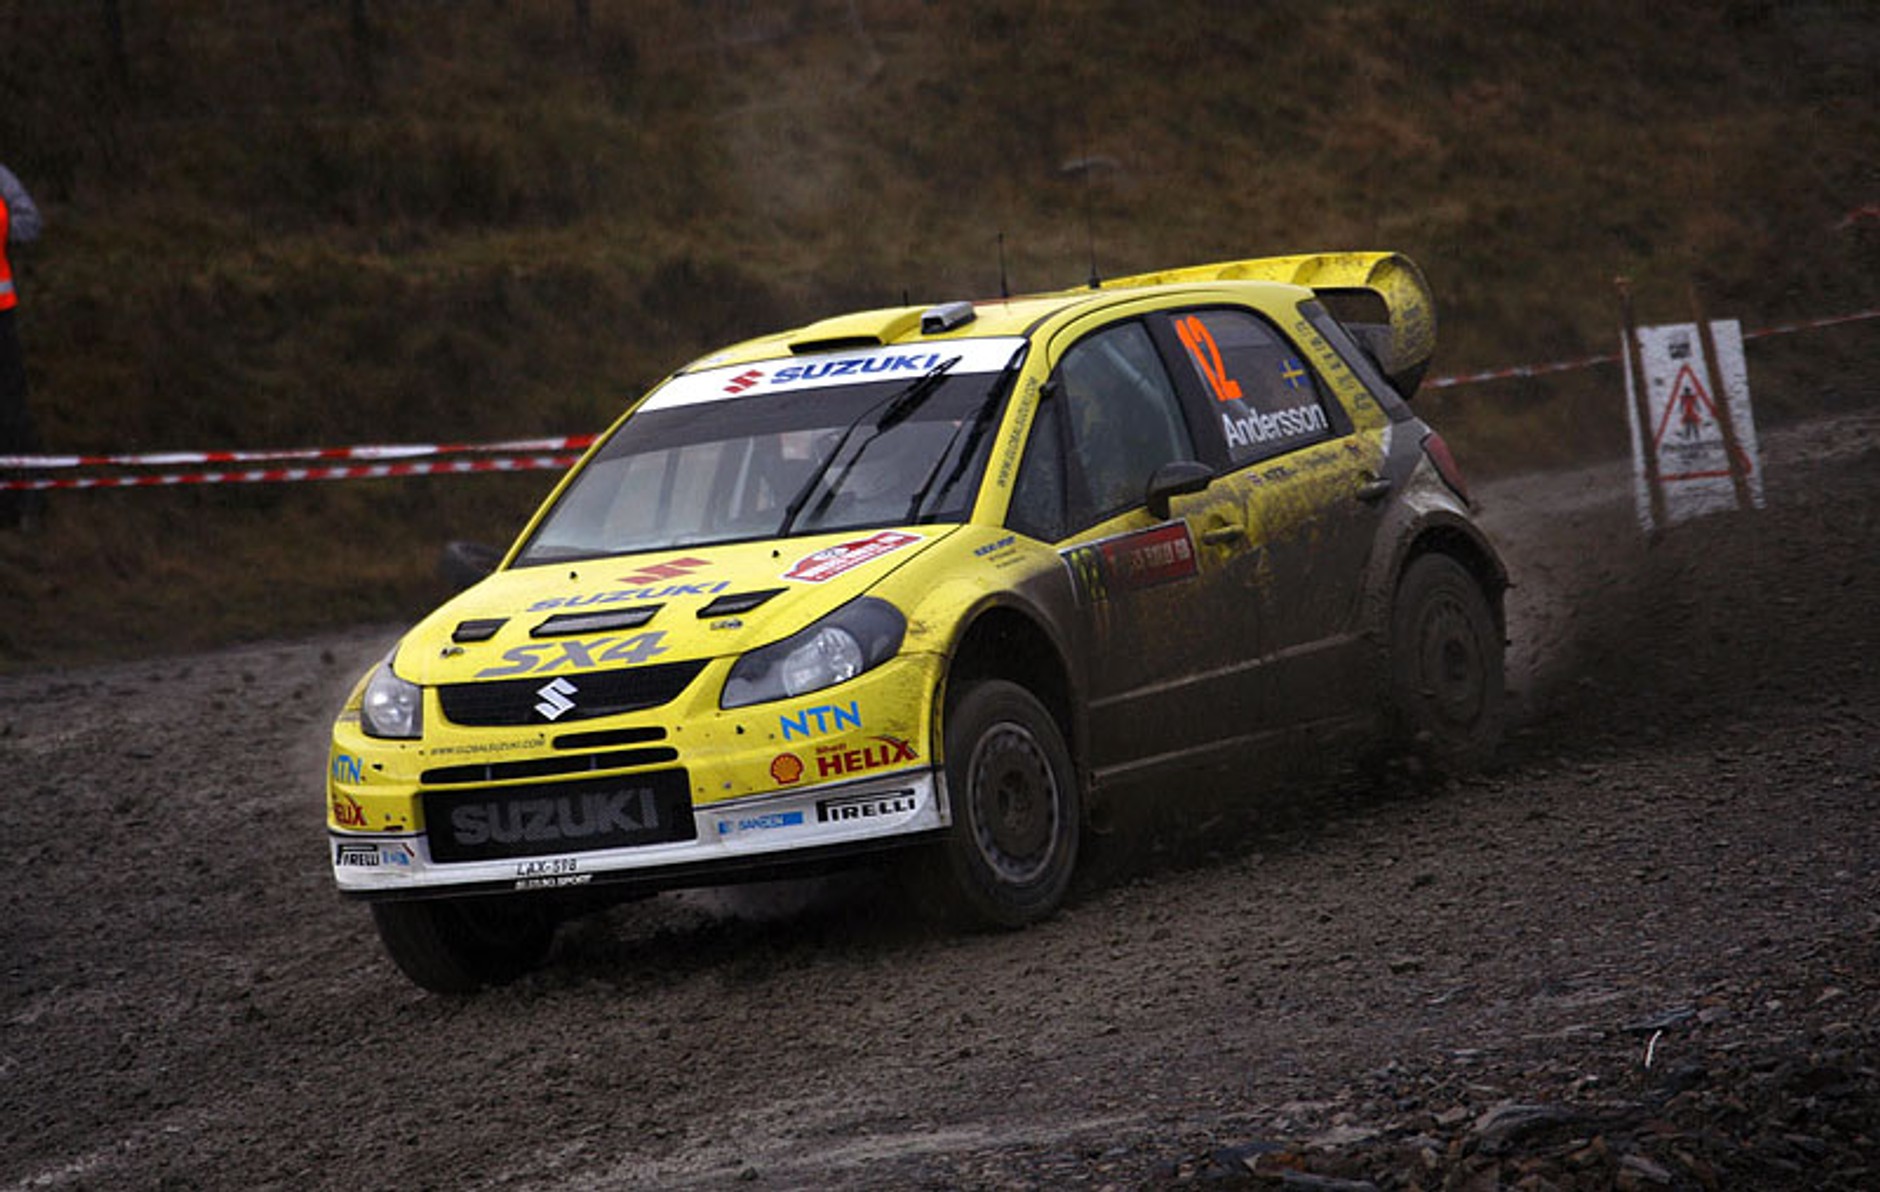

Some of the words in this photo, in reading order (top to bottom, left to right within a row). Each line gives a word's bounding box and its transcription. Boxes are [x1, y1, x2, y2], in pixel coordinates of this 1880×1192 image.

[770, 353, 941, 384] SUZUKI
[1174, 315, 1243, 402] 12
[1222, 402, 1329, 448] Andersson
[526, 581, 731, 612] SUZUKI
[474, 630, 671, 678] SX4
[780, 701, 862, 740] NTN
[817, 738, 917, 777] HELIX
[452, 788, 659, 845] SUZUKI
[815, 787, 915, 823] PIRELLI
